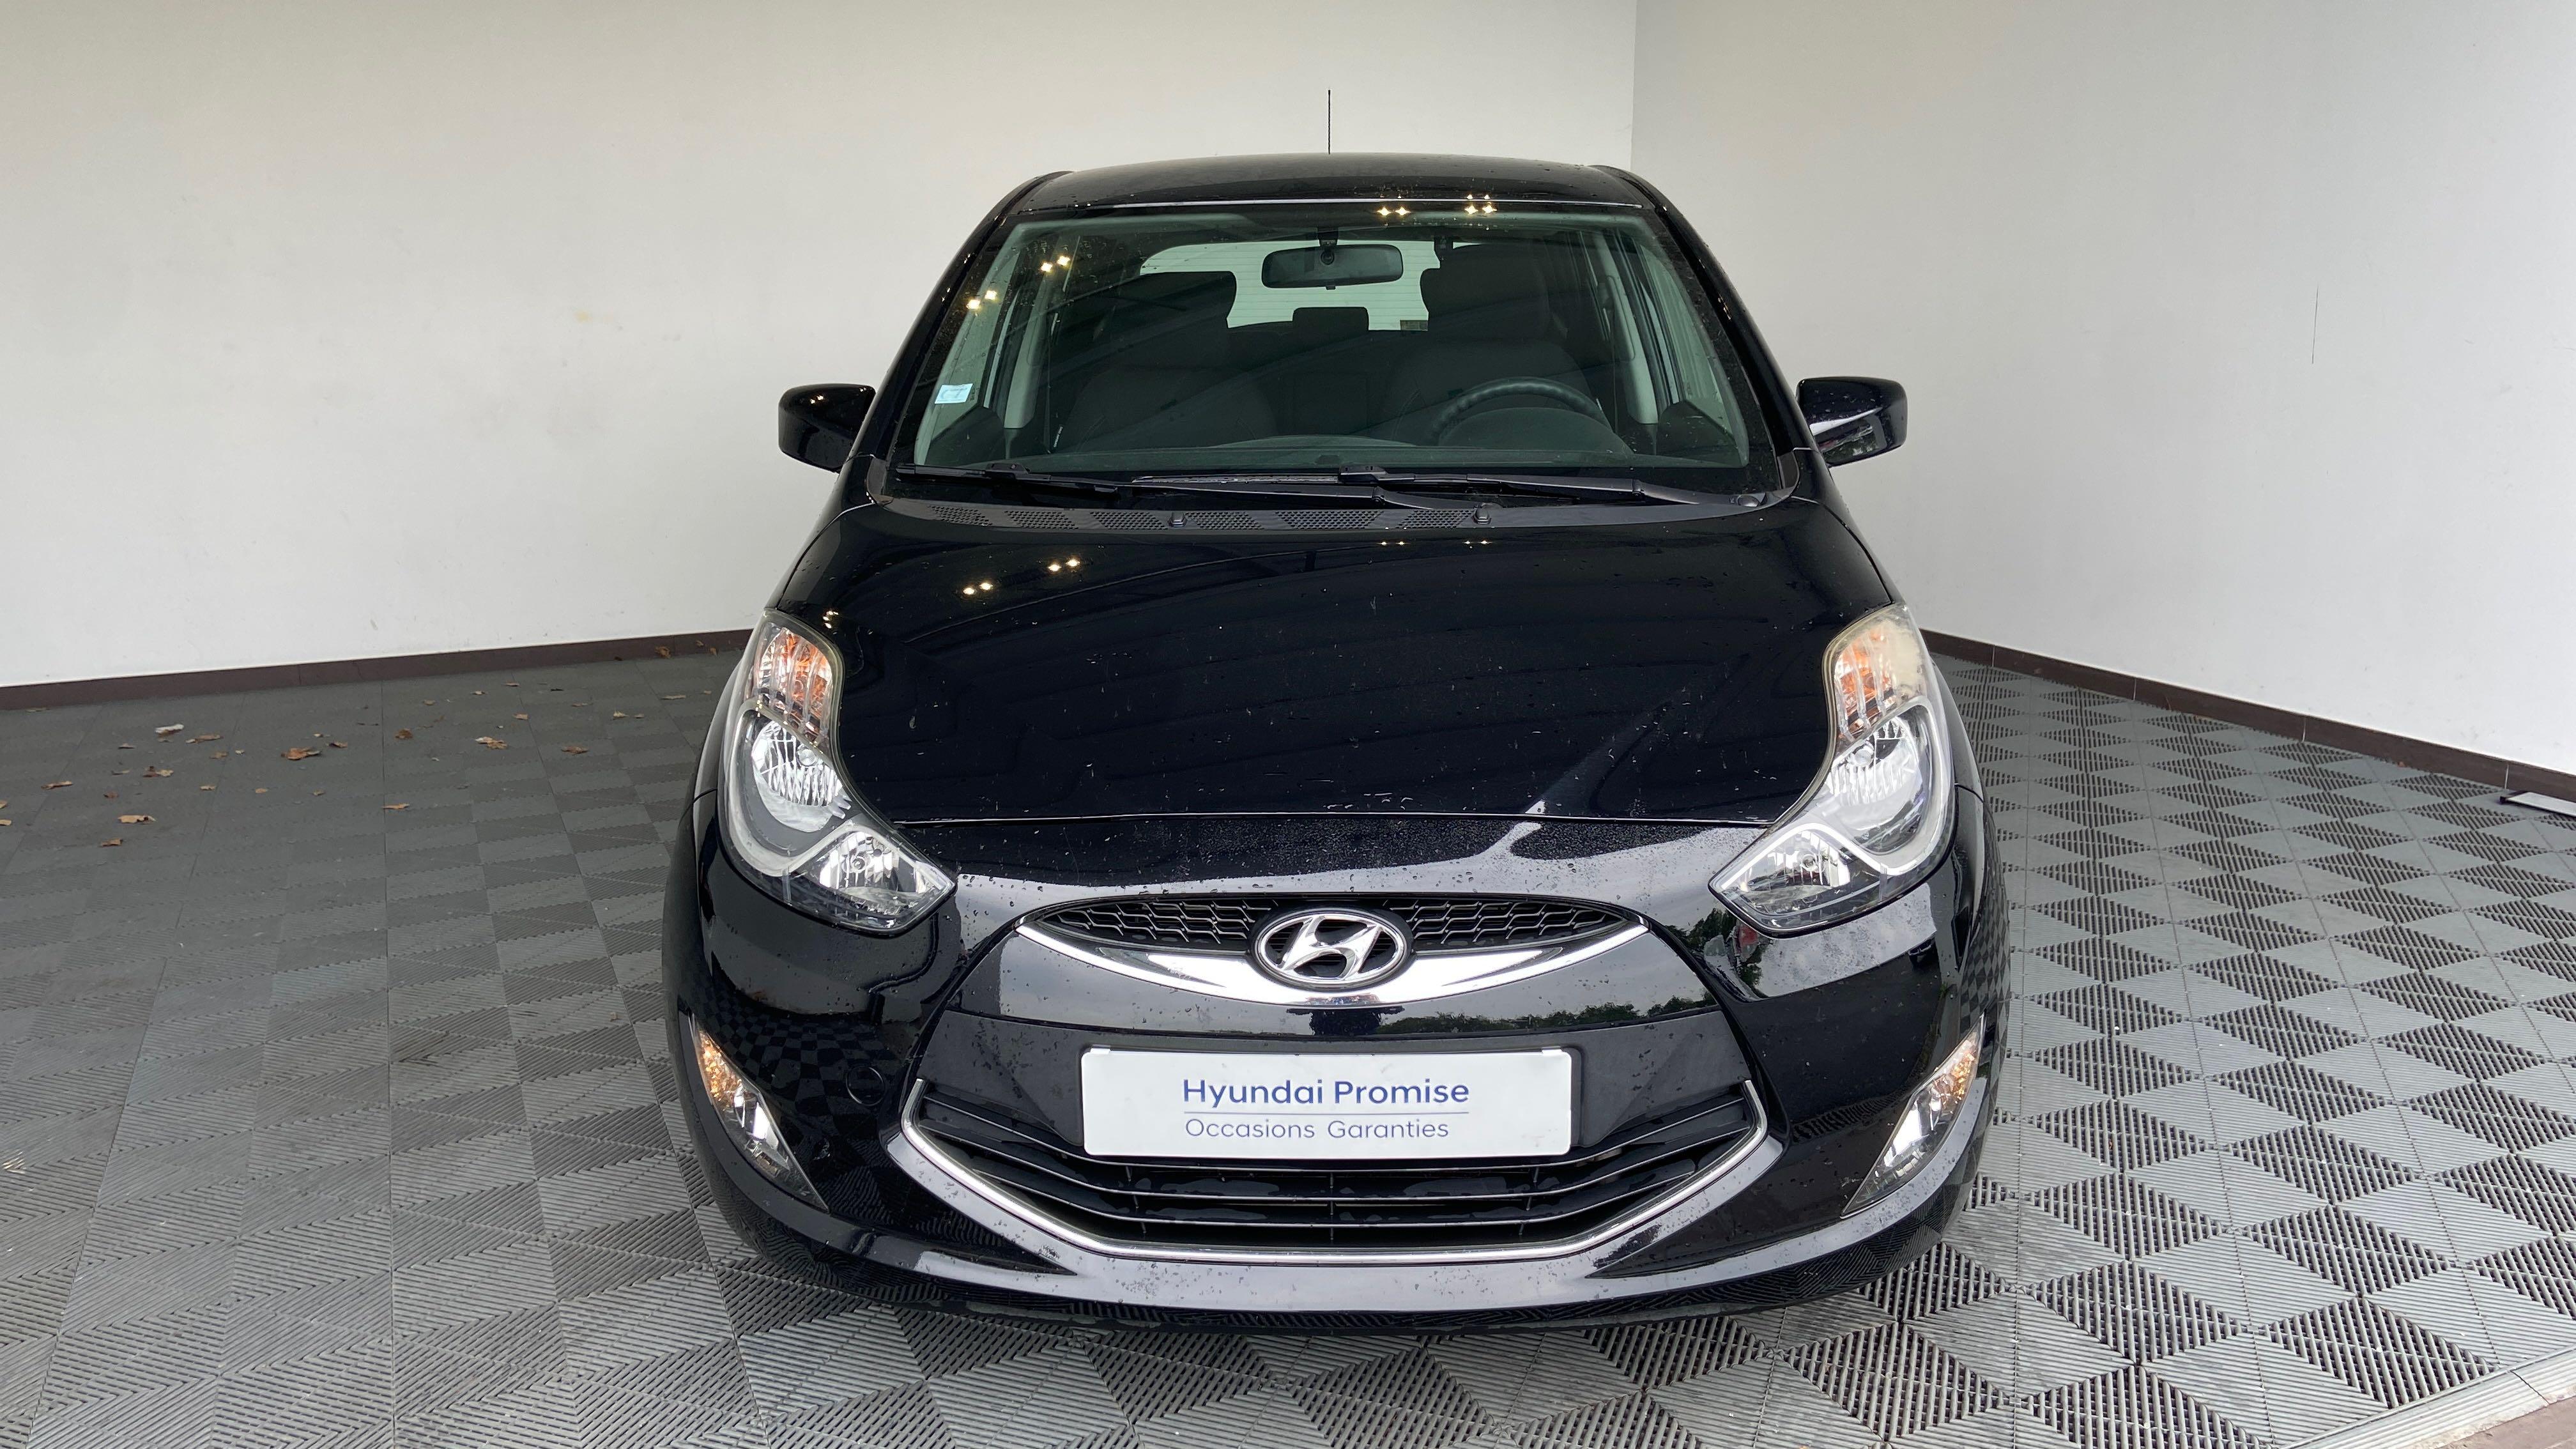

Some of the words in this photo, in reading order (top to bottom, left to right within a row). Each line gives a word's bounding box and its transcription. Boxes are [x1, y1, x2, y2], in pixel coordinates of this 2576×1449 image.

[1183, 1078, 1322, 1108] Hyundai
[1335, 1078, 1469, 1104] Promise
[1185, 1118, 1315, 1138] Occasions
[1328, 1119, 1449, 1139] Garanties
